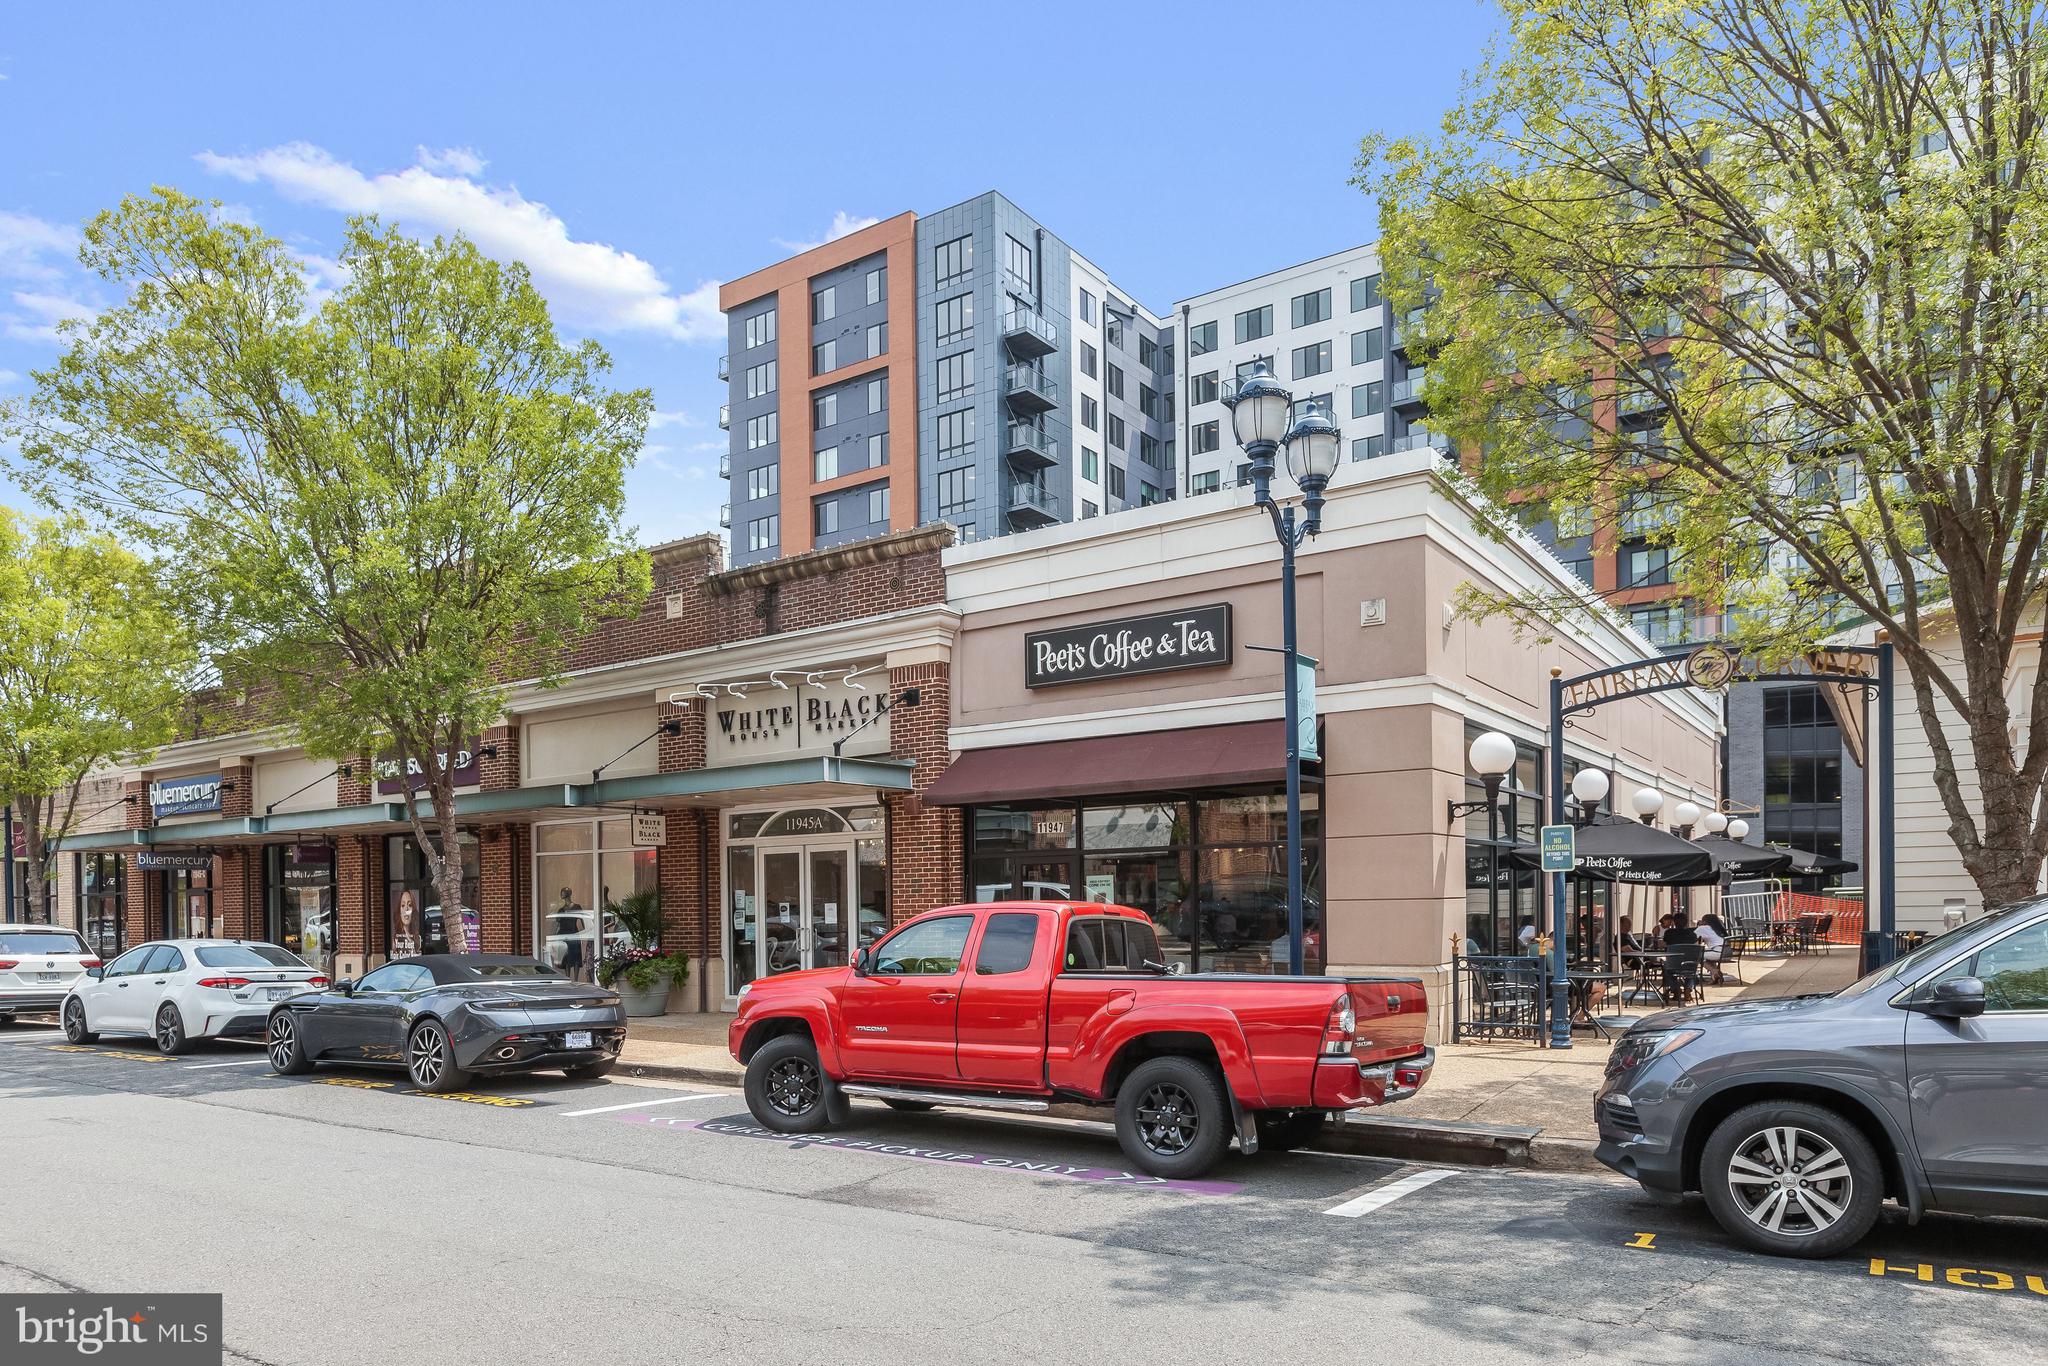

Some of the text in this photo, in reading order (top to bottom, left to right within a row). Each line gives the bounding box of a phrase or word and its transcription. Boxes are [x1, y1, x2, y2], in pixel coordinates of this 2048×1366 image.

[1033, 619, 1217, 675] Peet's Coffee & Tea
[1569, 659, 1683, 705] FAIRFAX
[806, 693, 889, 722] BLACK
[717, 705, 793, 733] WHITE
[730, 728, 780, 742] HOUSE
[149, 781, 220, 807] bluemercury
[638, 818, 661, 826] WHITE
[785, 816, 823, 831] 11945A
[1038, 822, 1064, 833] 11947
[638, 830, 661, 838] BLACK
[137, 852, 214, 868] bluemercury
[1607, 856, 1633, 869] Coffee
[855, 1025, 889, 1033] TACOMA
[849, 1141, 975, 1161] PICKUP
[981, 1158, 1090, 1175] ONLY
[1624, 1232, 1657, 1250] 1
